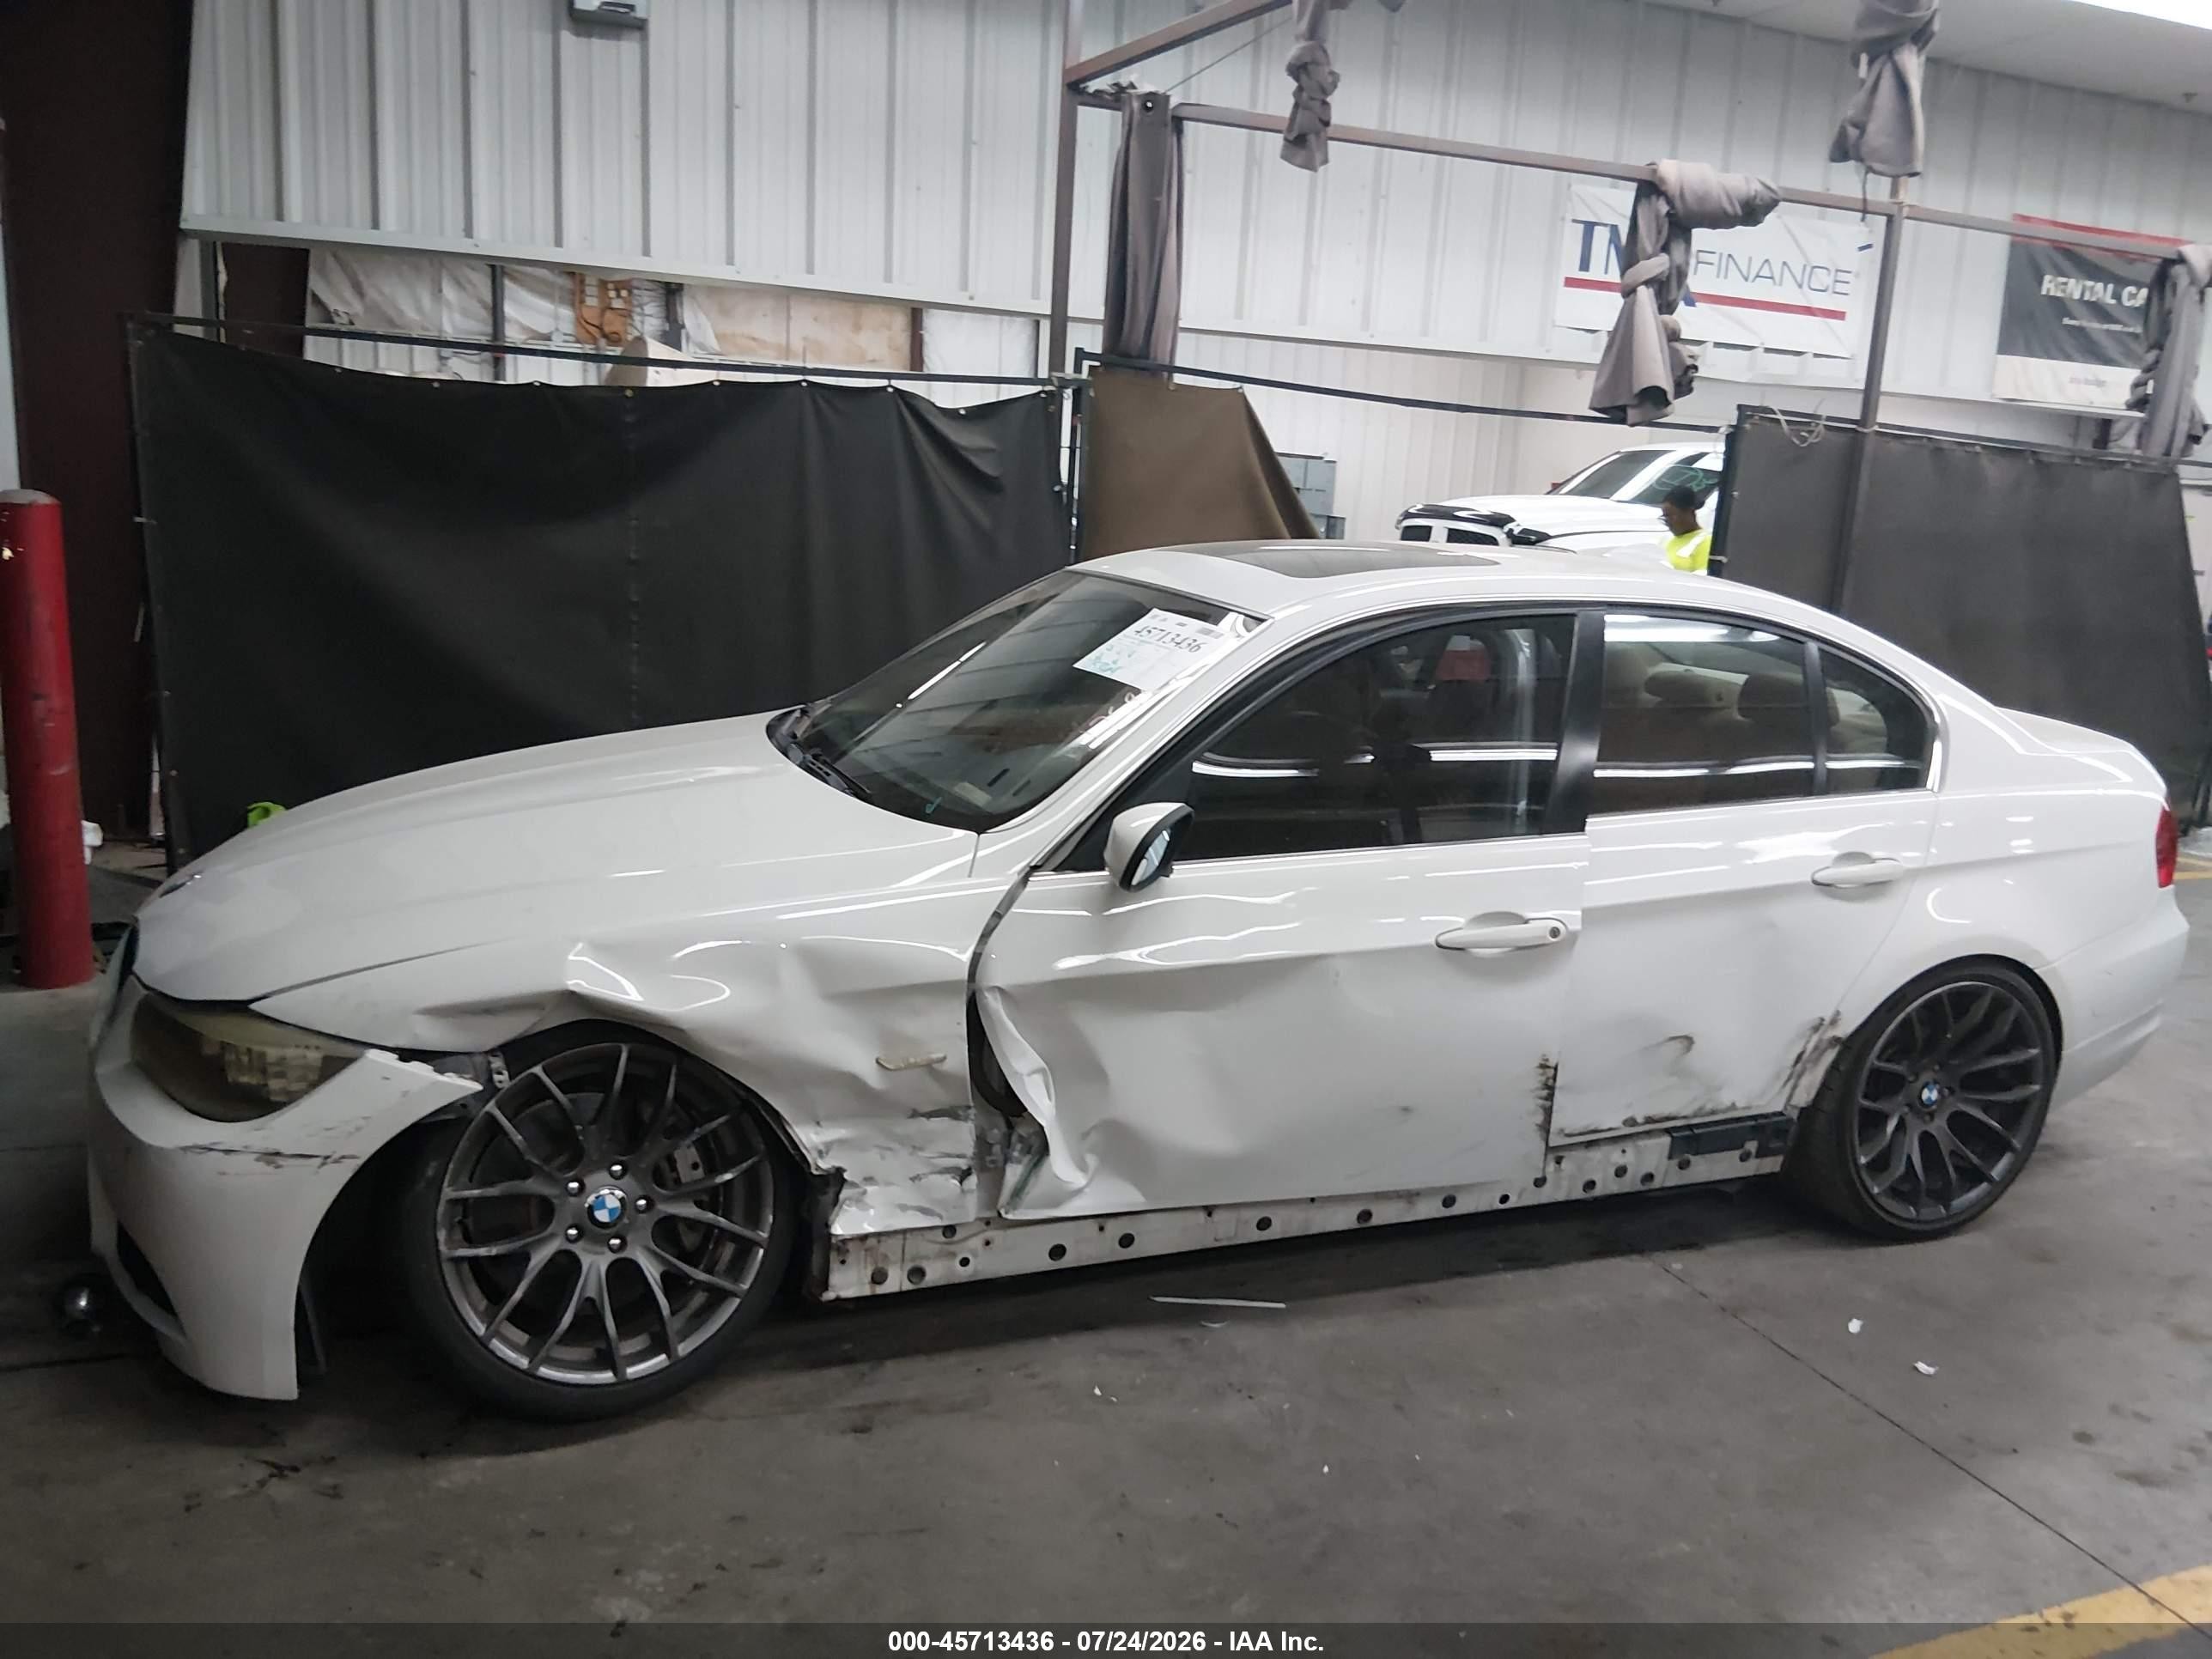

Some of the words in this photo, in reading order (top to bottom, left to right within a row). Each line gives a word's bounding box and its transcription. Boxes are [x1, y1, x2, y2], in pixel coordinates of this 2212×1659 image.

[1693, 249, 1853, 296] FINANCE
[2040, 274, 2117, 305] RENTAL
[2121, 285, 2149, 307] CA
[1134, 625, 1208, 653] 45713436
